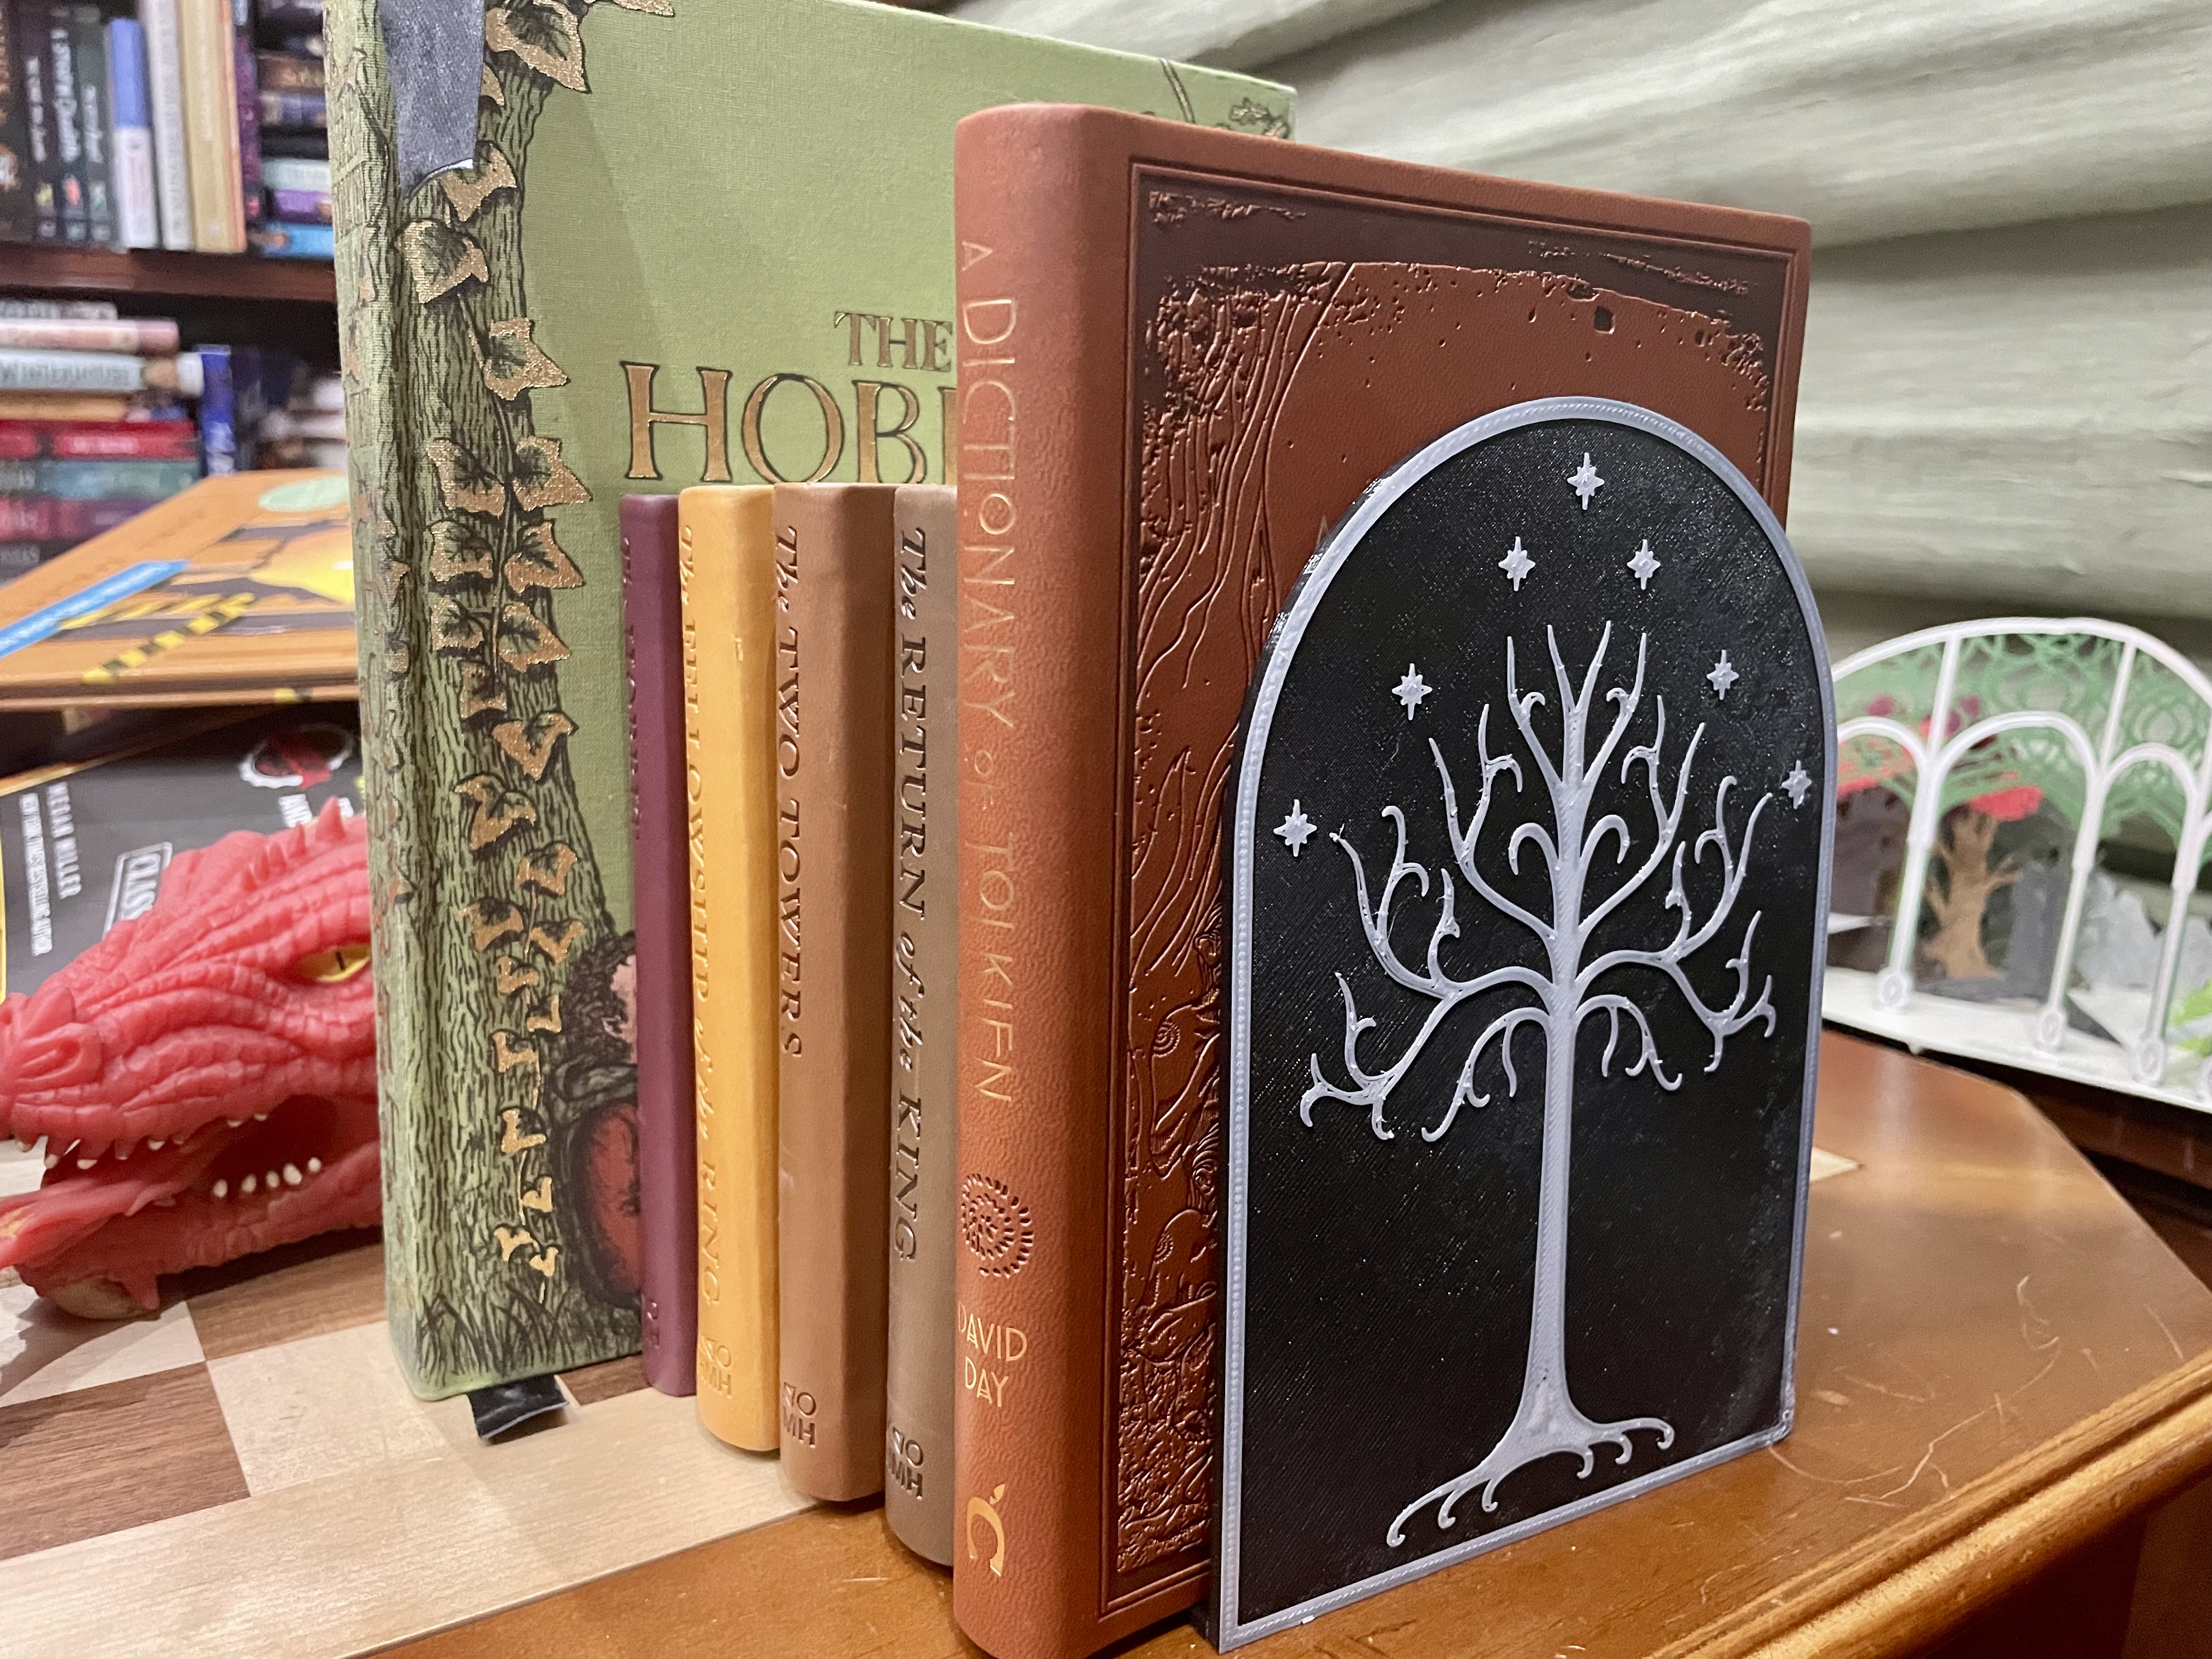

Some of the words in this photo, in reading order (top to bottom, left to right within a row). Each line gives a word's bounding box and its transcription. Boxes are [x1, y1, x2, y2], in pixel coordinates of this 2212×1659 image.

[961, 240, 994, 272] A
[833, 311, 954, 373] THE
[619, 360, 957, 484] HOB
[962, 297, 1017, 729] DICTIONARY
[776, 525, 799, 613] The
[899, 527, 927, 620] The
[778, 627, 800, 780] TWO
[899, 633, 927, 921] RETURN
[779, 798, 803, 1058] TOWERS
[896, 930, 925, 999] of
[899, 995, 923, 1073] the
[895, 1087, 922, 1262] KING
[701, 1159, 721, 1306] RING
[958, 1300, 1028, 1362] DAVID
[965, 1356, 1009, 1408] DAY
